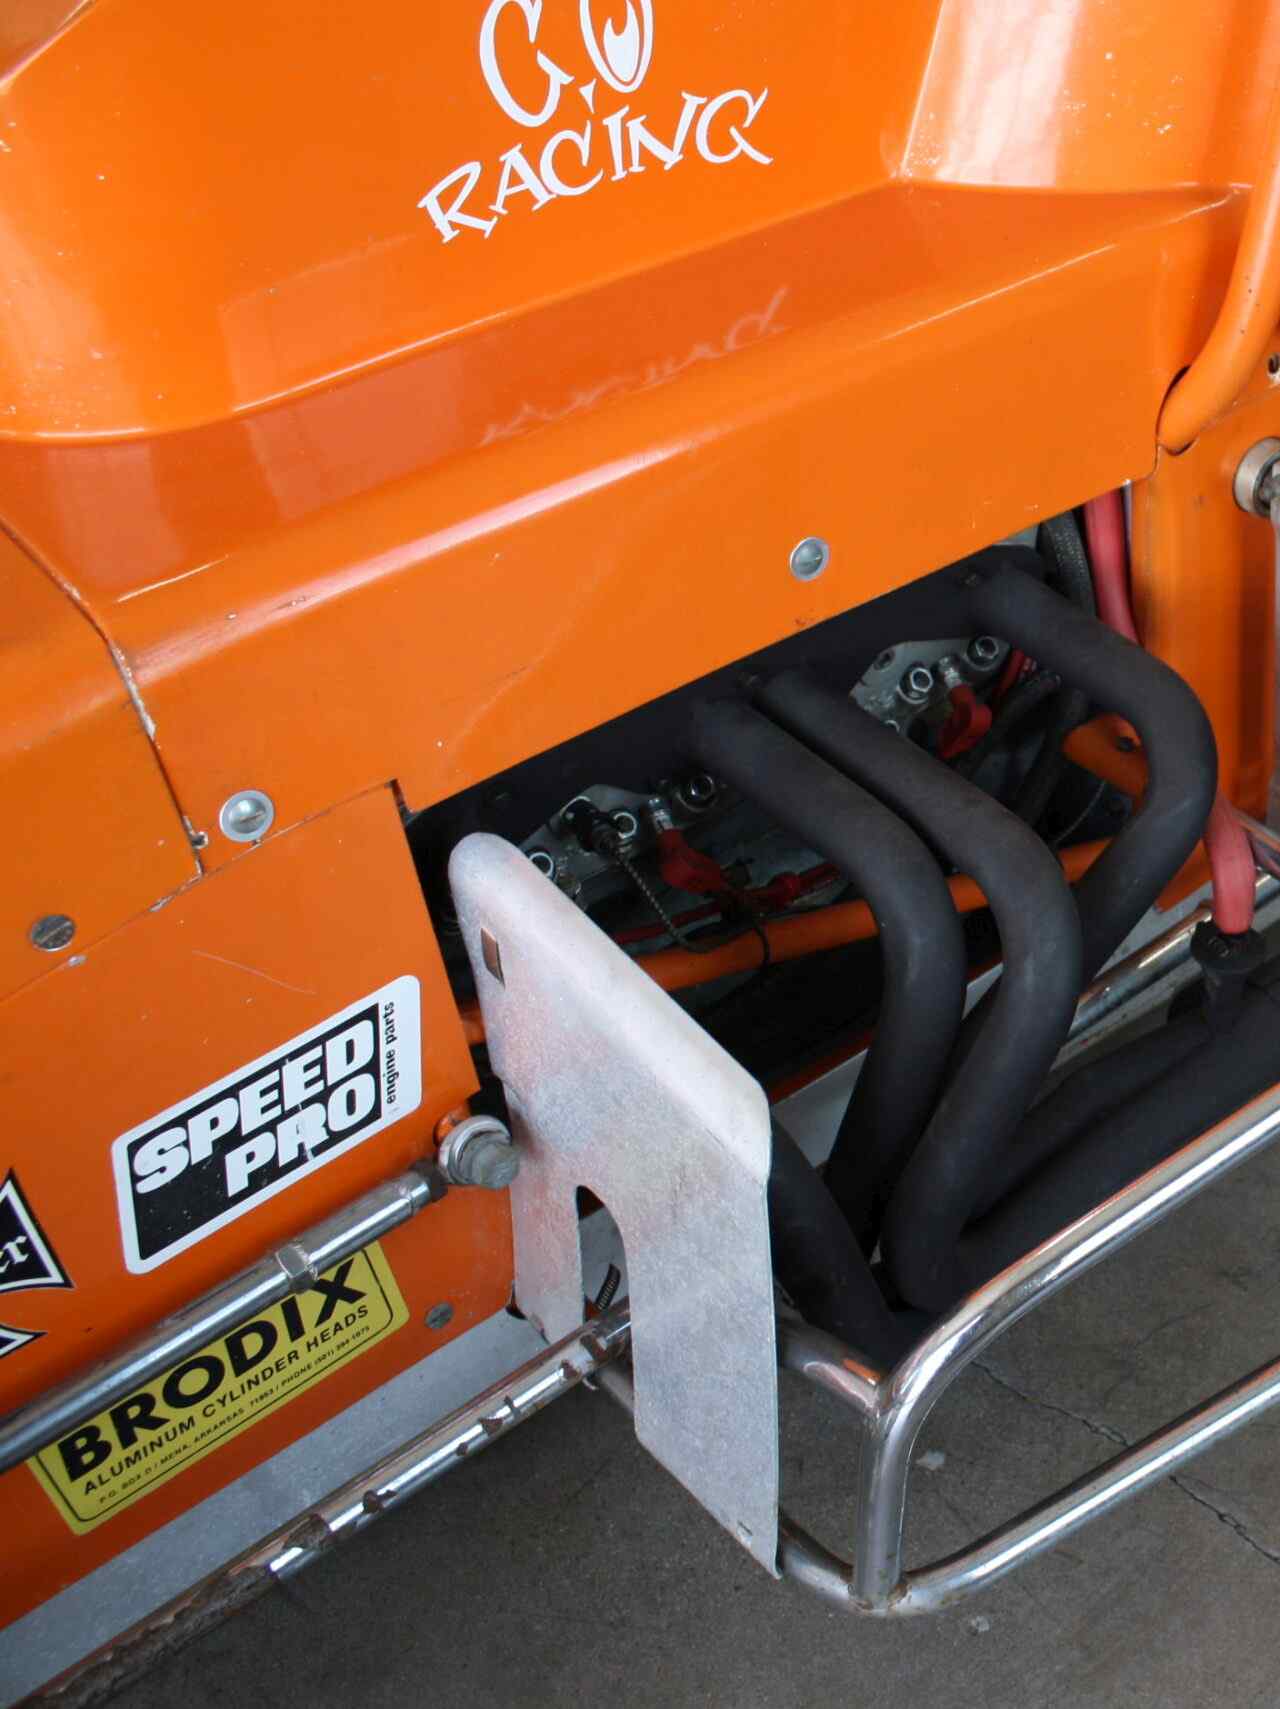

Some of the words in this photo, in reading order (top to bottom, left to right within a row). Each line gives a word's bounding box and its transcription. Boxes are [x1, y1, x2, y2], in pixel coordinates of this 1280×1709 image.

[417, 87, 774, 243] RACING
[382, 1048, 400, 1105] engine
[383, 1001, 397, 1045] parts
[133, 1019, 374, 1194] SPEED
[225, 1073, 376, 1198] PRO
[57, 1257, 366, 1483] BRODIX
[84, 1416, 195, 1495] ALUMINUM
[202, 1350, 300, 1418] CYLINDER
[306, 1305, 369, 1353] HEADS
[194, 1408, 245, 1443] ARKANSAS
[281, 1363, 312, 1387] PHONE
